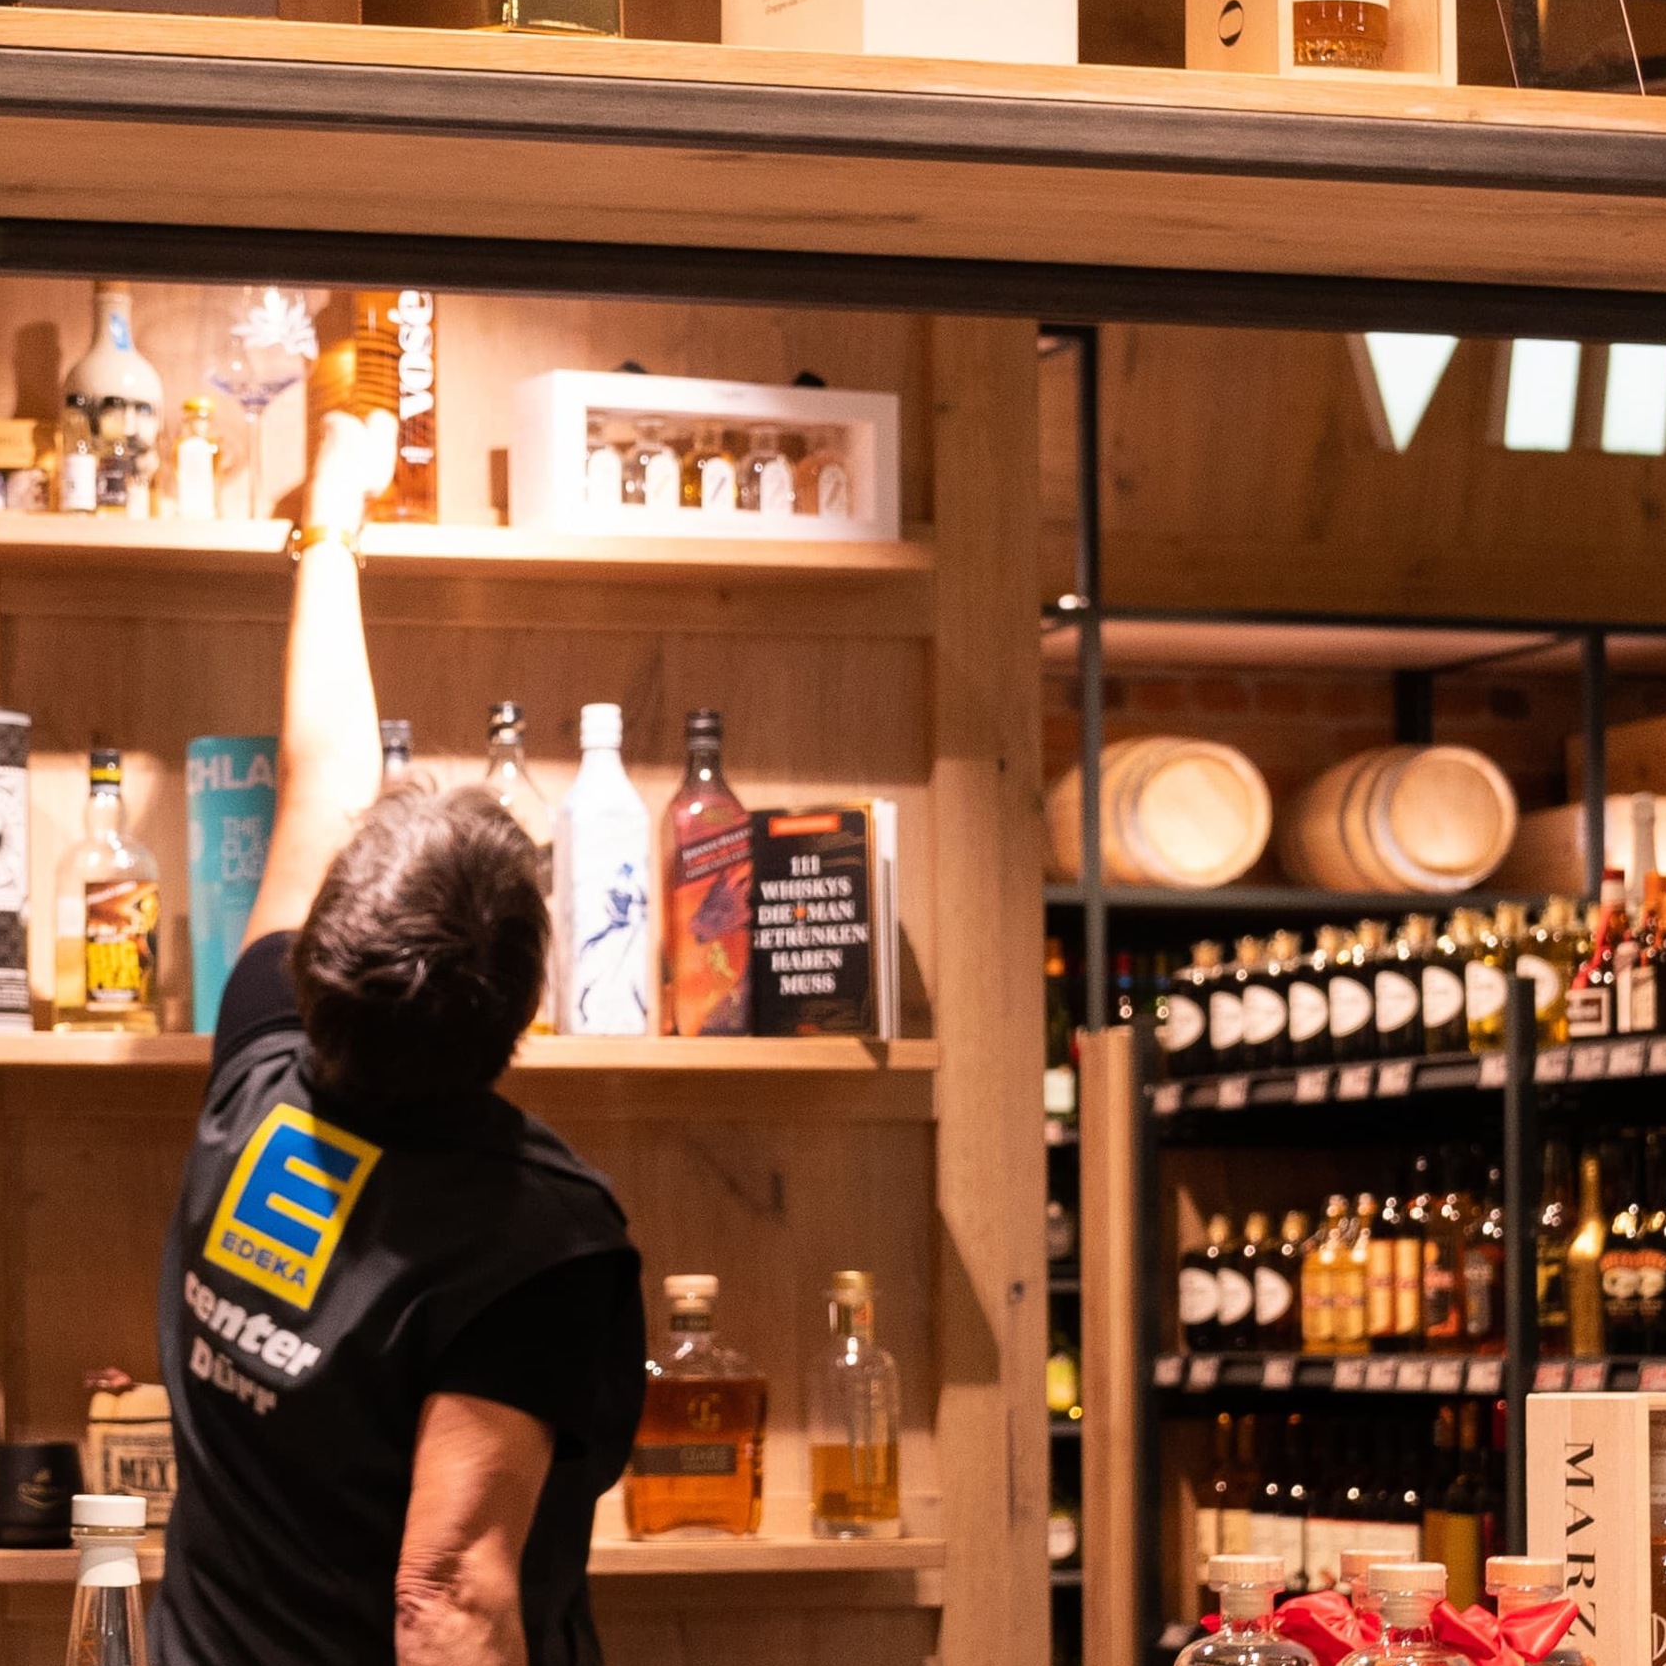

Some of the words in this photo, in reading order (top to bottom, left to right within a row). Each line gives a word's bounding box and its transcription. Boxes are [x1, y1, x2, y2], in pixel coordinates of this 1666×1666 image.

[791, 853, 821, 876] 111
[760, 875, 853, 901] WHISKYS
[758, 903, 794, 925] DIE
[806, 900, 856, 923] MAN
[771, 948, 844, 973] HABEN
[779, 972, 837, 996] MUSS
[219, 1230, 308, 1290] EDEKA
[183, 1271, 322, 1377] center
[1565, 1439, 1597, 1639] MARZ
